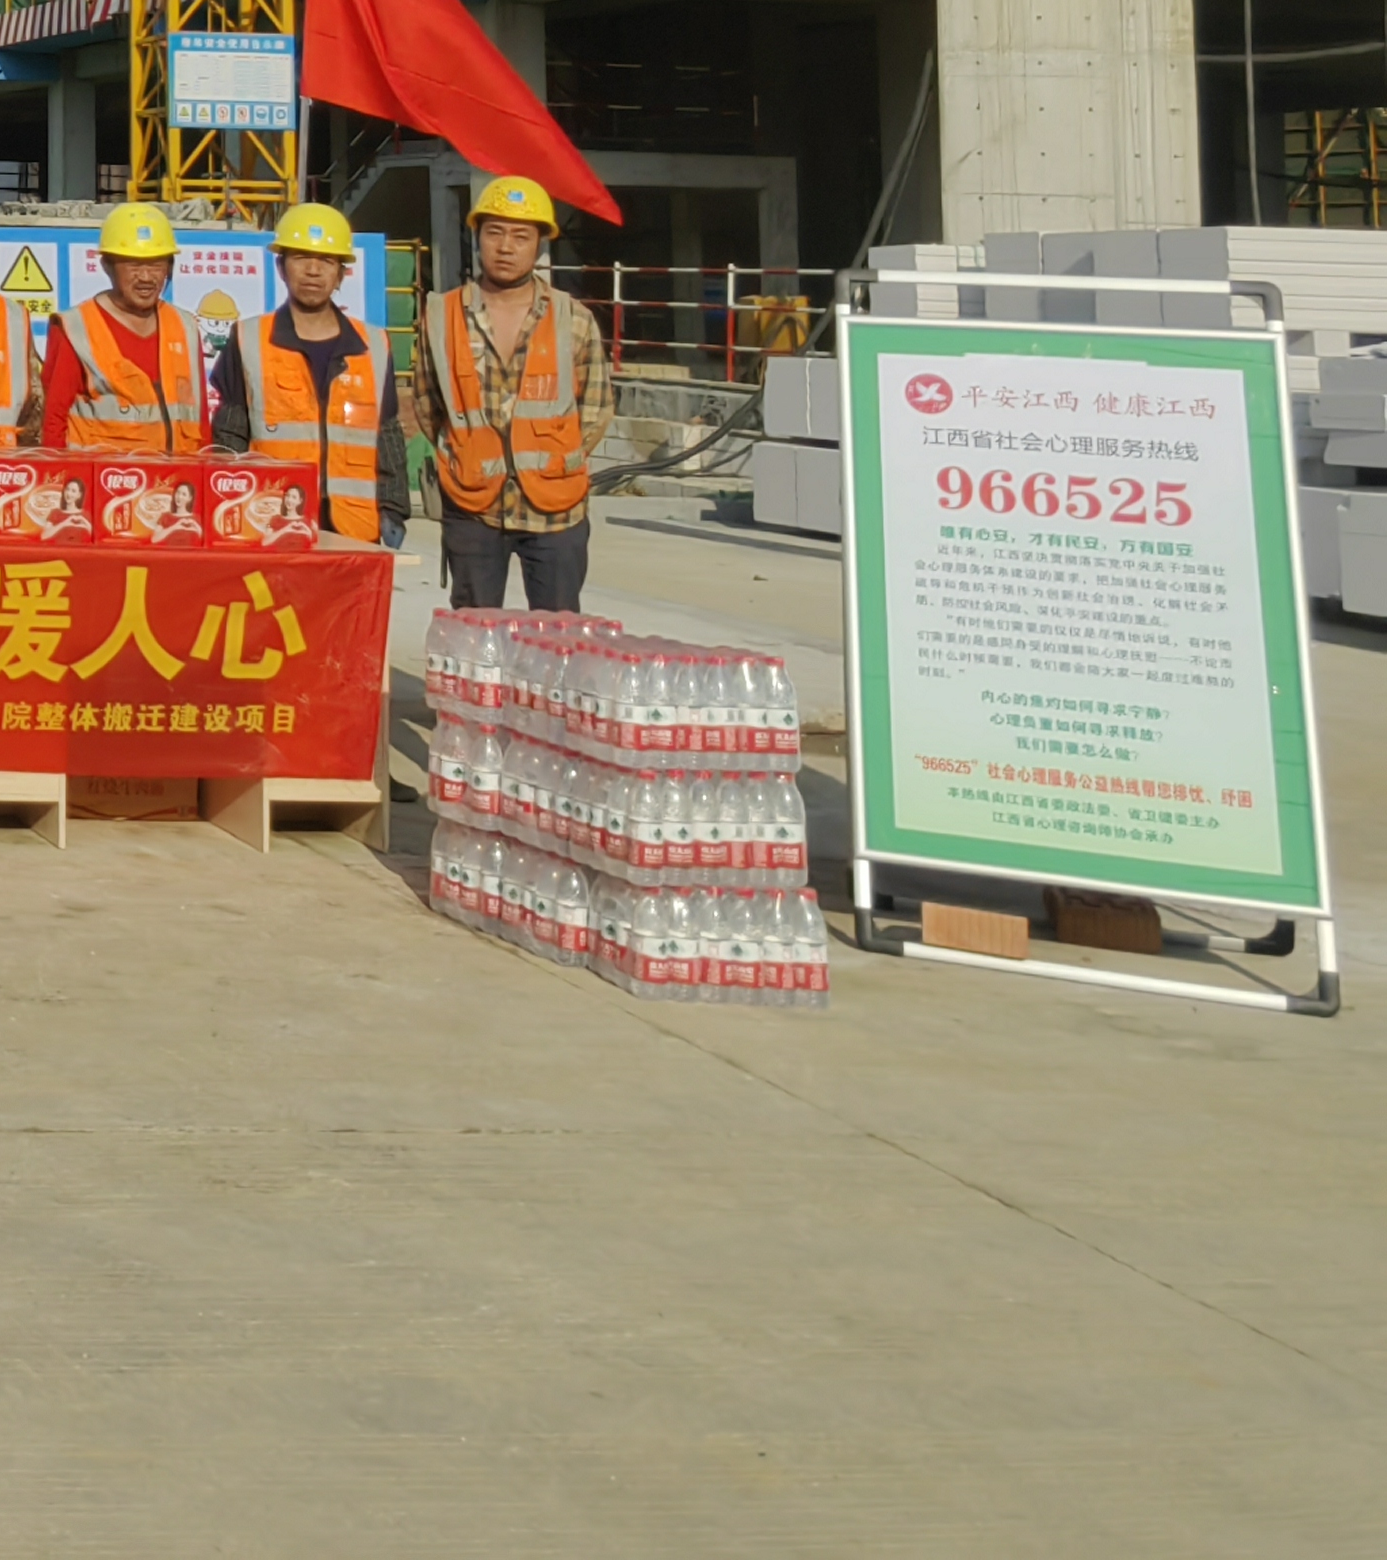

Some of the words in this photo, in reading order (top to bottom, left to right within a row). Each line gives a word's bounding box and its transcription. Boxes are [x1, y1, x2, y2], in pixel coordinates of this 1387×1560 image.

[961, 385, 1078, 413] 平安江西
[1093, 391, 1216, 420] 健康江西
[922, 426, 1200, 462] 江西省社会心理服务热线
[936, 465, 1193, 527] 966525
